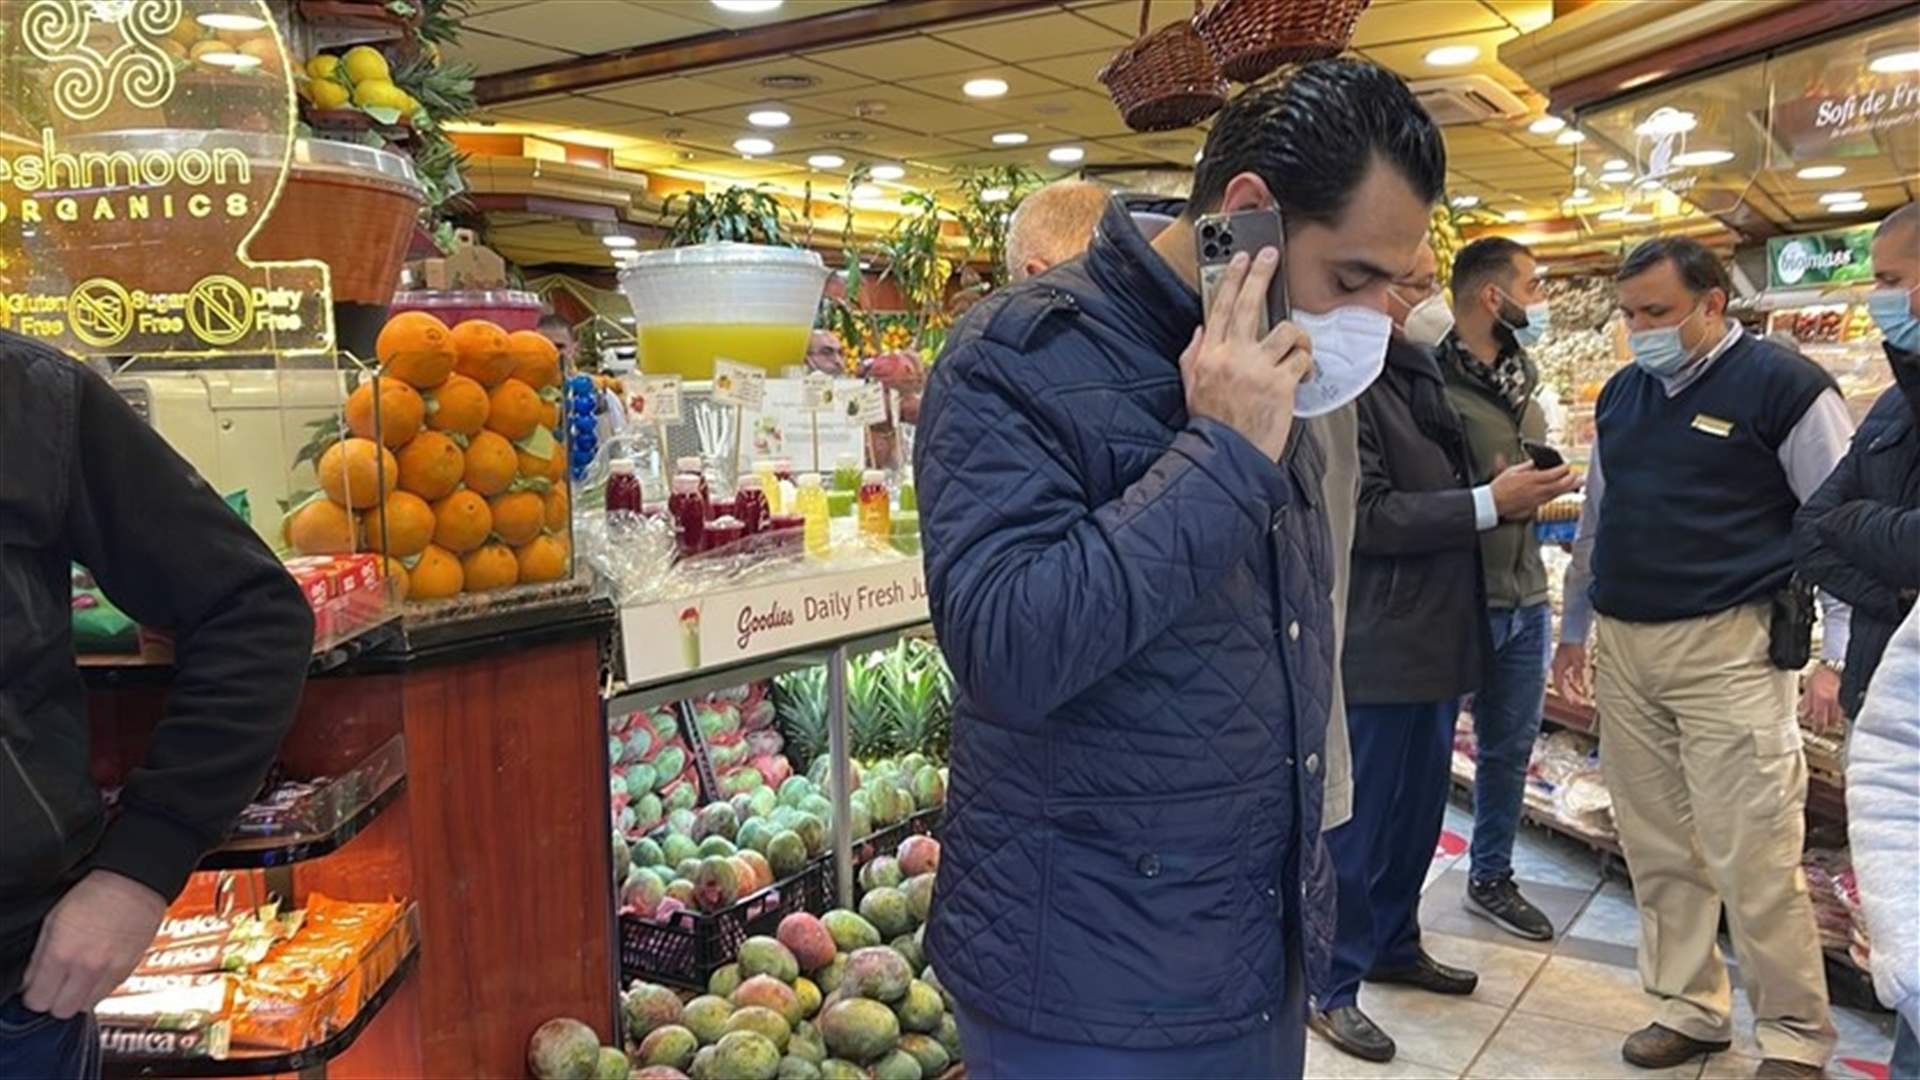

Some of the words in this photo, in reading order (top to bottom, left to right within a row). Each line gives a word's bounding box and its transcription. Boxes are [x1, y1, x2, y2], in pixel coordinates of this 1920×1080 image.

[1859, 88, 1887, 116] de
[9, 293, 67, 313] Gluten
[131, 290, 188, 312] Sugar
[252, 287, 302, 310] Dairy
[21, 316, 64, 336] Free
[139, 314, 184, 334] Free
[256, 312, 301, 332] Free
[737, 601, 795, 650] Goodies
[803, 591, 851, 622] Daily
[857, 580, 904, 612] Fresh
